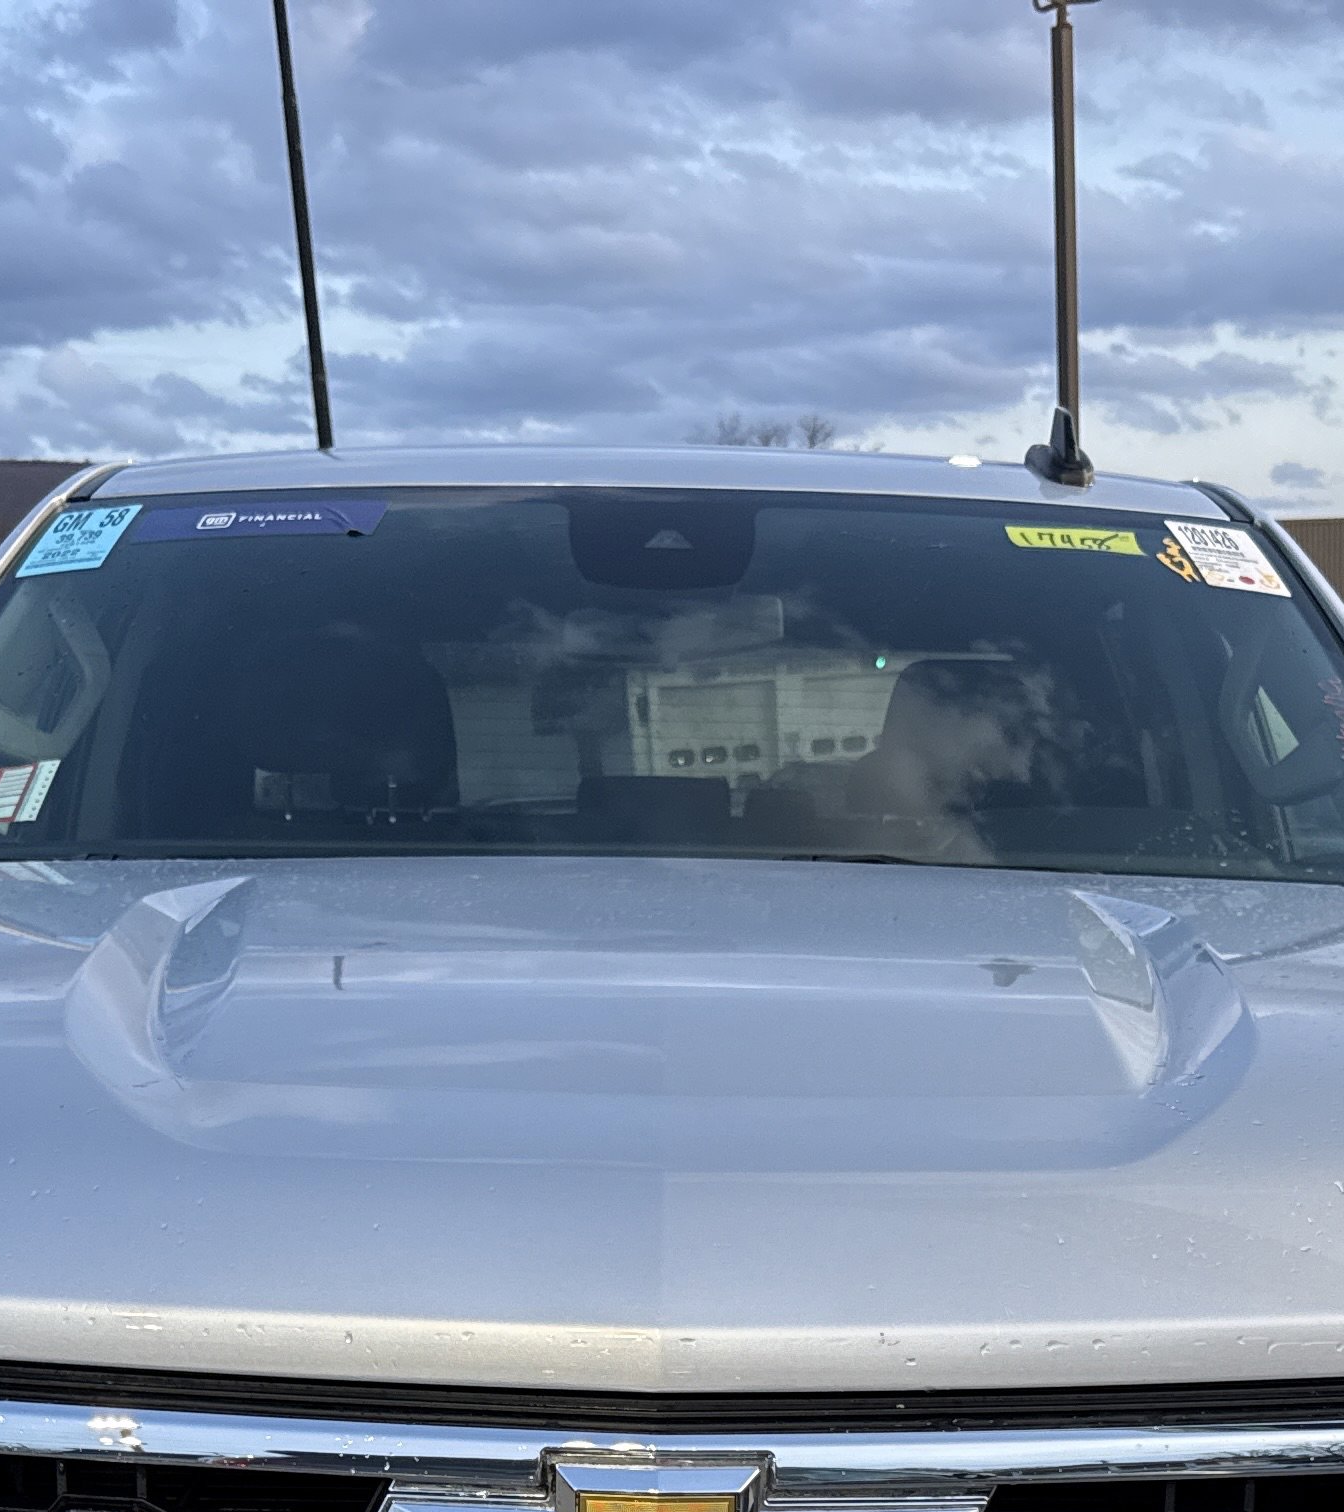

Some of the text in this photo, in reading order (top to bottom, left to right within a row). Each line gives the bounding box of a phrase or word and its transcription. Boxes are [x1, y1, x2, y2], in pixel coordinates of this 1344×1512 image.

[53, 507, 131, 533] GM 58
[238, 512, 323, 523] FINANCIAL
[1177, 525, 1240, 551] 1201426
